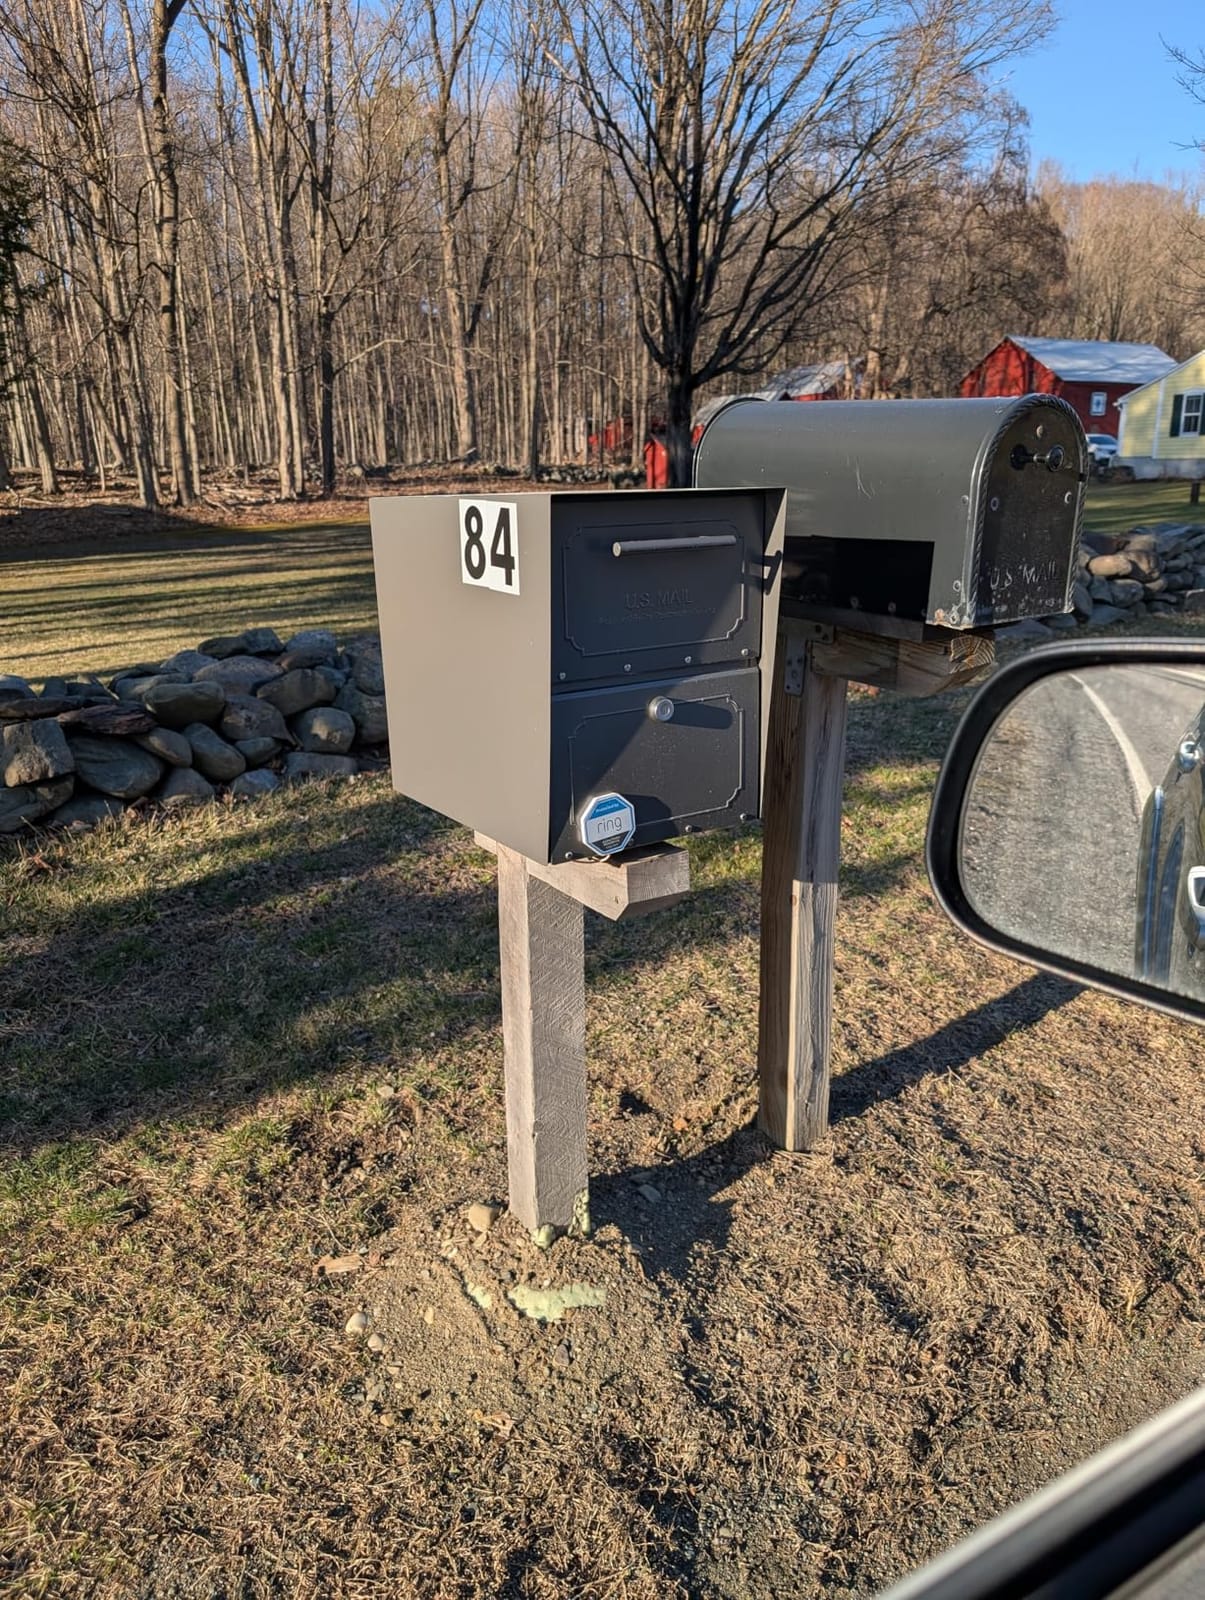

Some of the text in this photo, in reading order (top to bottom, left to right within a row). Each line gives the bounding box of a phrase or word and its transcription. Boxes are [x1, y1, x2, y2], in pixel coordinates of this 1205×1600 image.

[464, 505, 515, 586] 84
[625, 588, 696, 609] U.S. MAIL
[597, 816, 623, 833] ring
